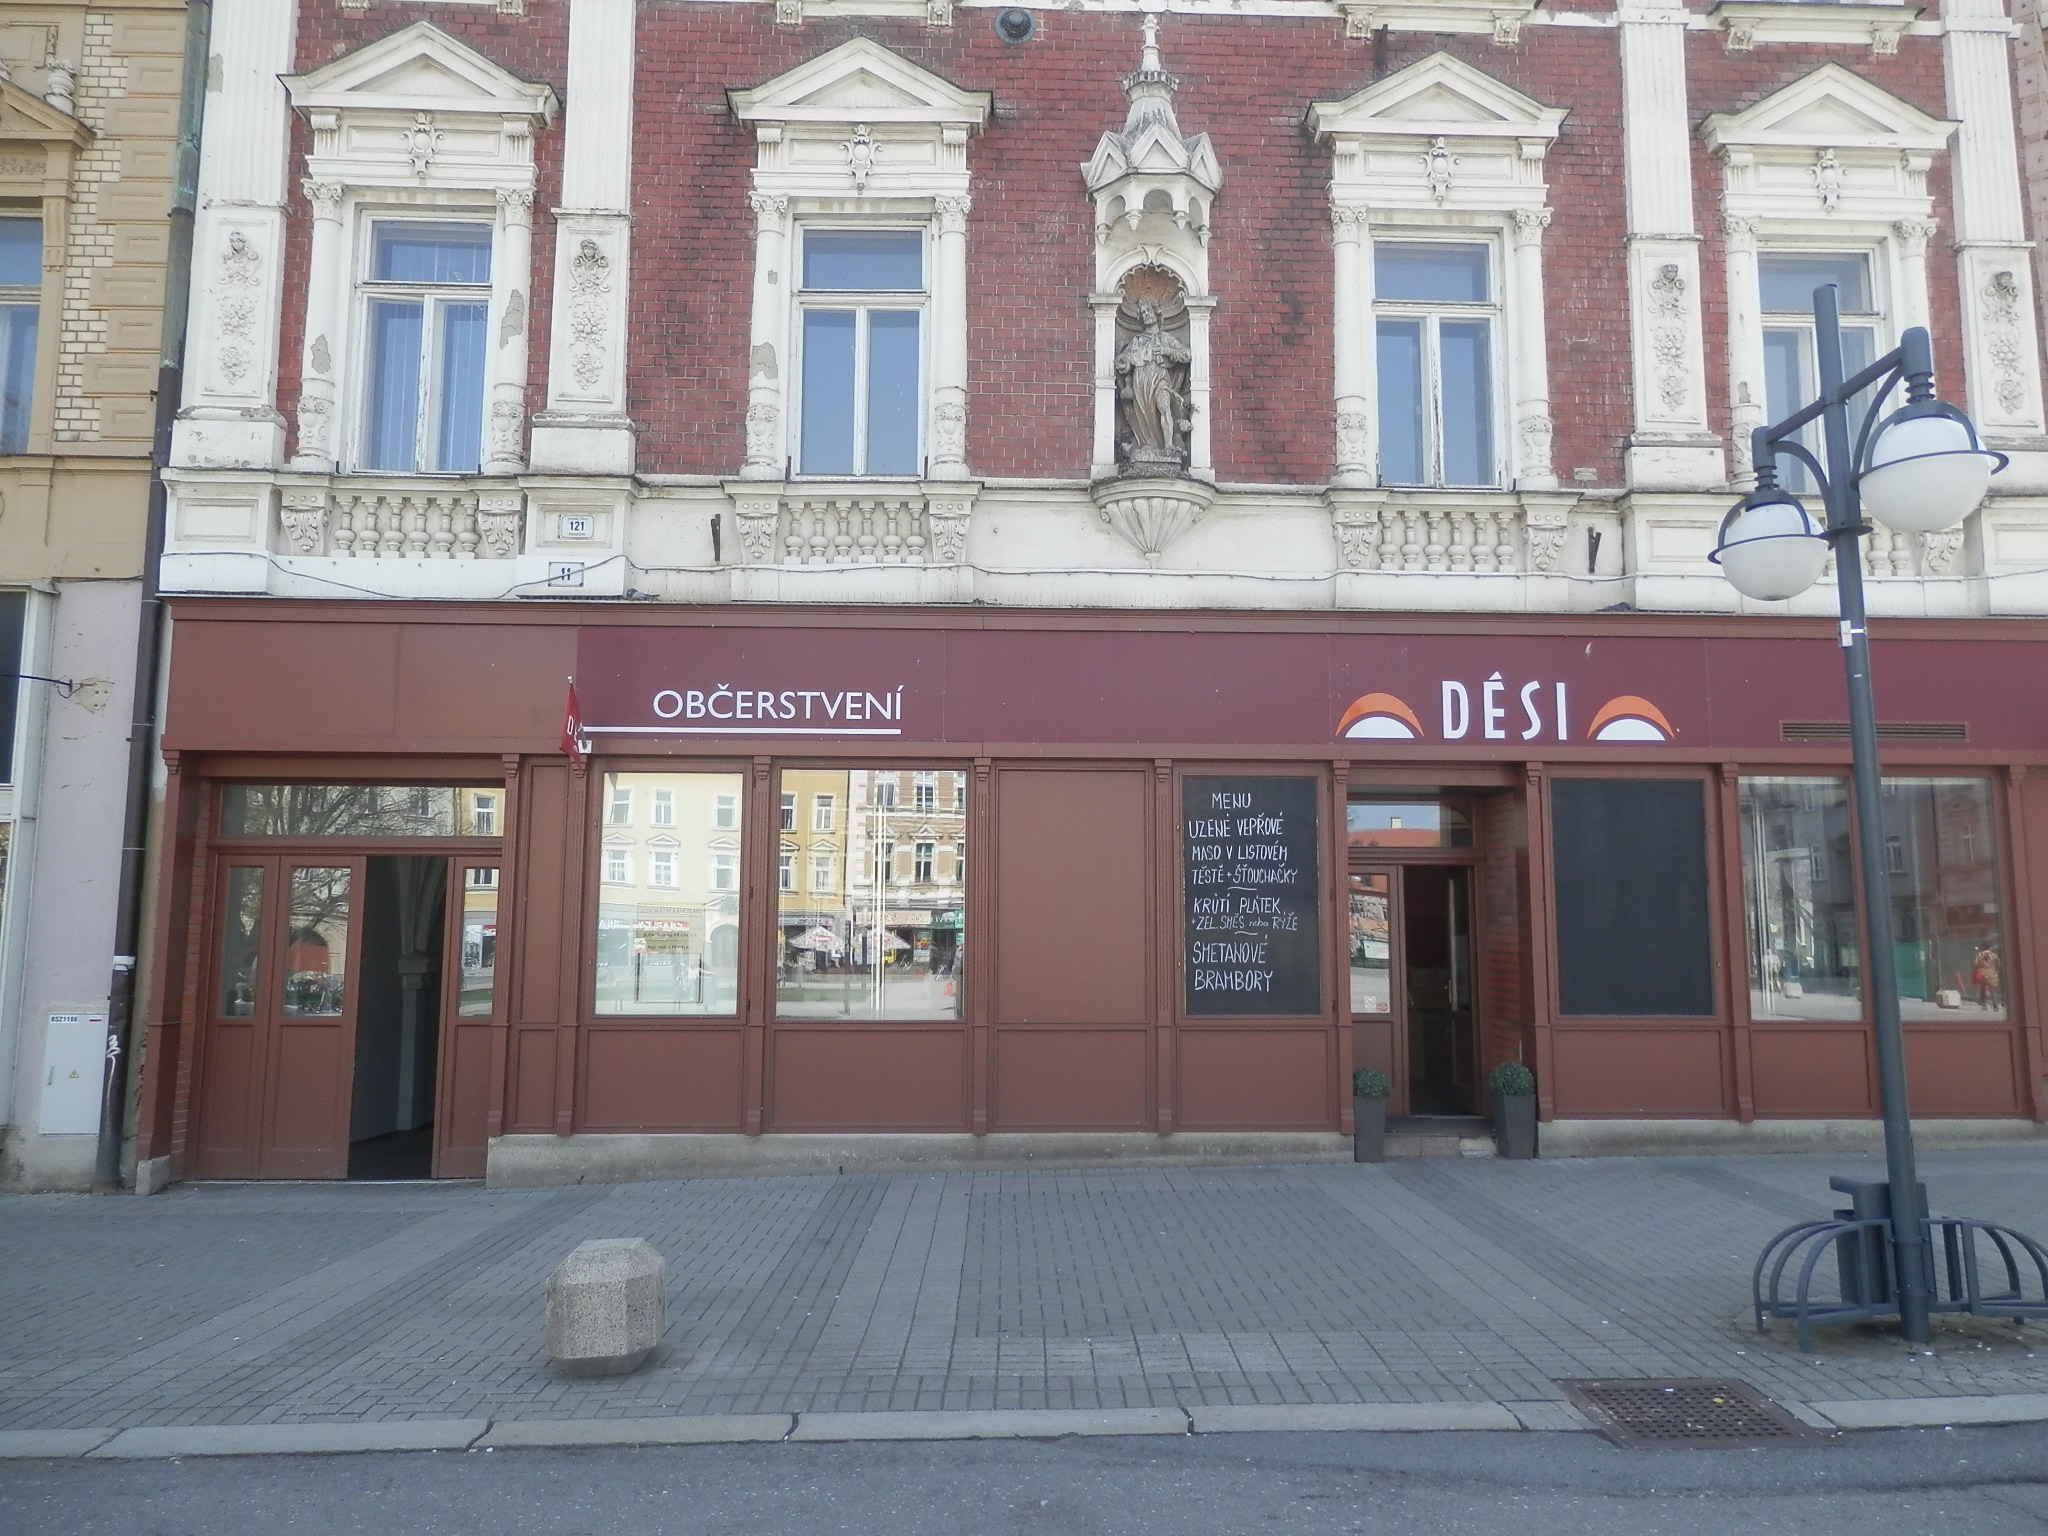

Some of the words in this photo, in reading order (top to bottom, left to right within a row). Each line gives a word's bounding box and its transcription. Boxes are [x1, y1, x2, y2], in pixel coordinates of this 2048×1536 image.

[570, 521, 585, 531] 121
[653, 683, 904, 719] OBČERSTVENÍ
[1211, 792, 1251, 809] MENU
[1188, 812, 1231, 839] UZENÉ
[1237, 811, 1284, 836] VEPŘOVÉ
[1191, 845, 1222, 861] MASO
[1226, 845, 1233, 860] V
[1237, 840, 1288, 861] LISTOVÉM
[1192, 864, 1224, 884] TĚSTĚ
[1232, 862, 1298, 884] ŠŤOUCHAČKY
[1239, 895, 1281, 914] PLÁTEK
[1249, 917, 1269, 927] nebo
[1271, 911, 1298, 931] RÝŽE
[1192, 934, 1268, 964] SMETANOVÉ
[1194, 969, 1273, 993] BRAMBORY
